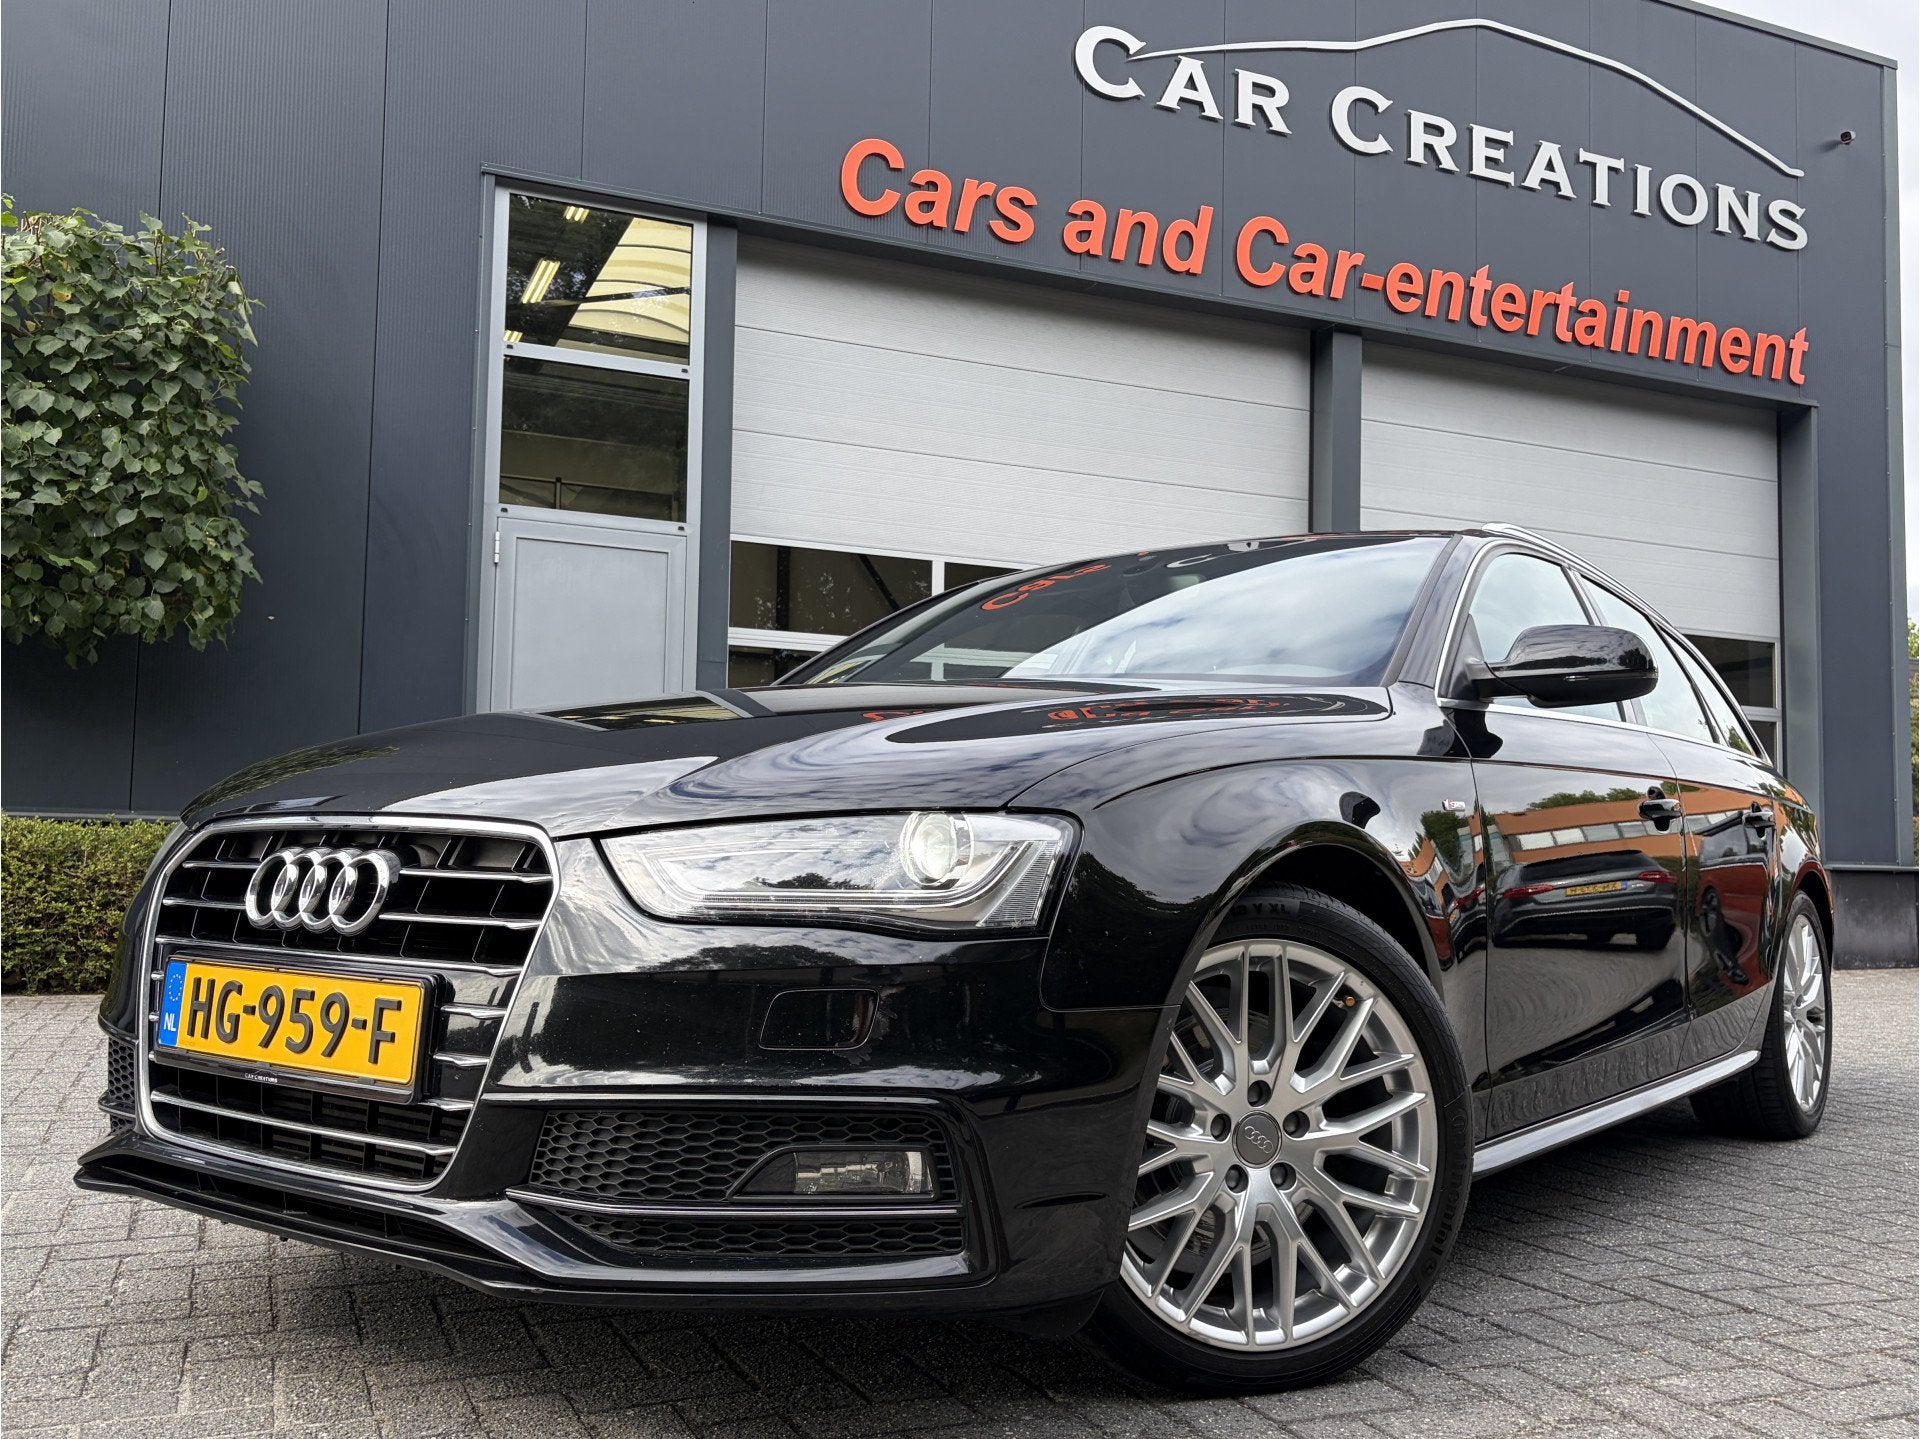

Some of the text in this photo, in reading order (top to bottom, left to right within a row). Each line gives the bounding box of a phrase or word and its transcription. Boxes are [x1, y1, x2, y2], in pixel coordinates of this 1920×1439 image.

[1075, 25, 1809, 251] CAR CREATIONS
[841, 138, 1809, 385] Cars and Car-entertainment
[163, 1012, 177, 1032] NL
[186, 975, 403, 1065] HG-959-F
